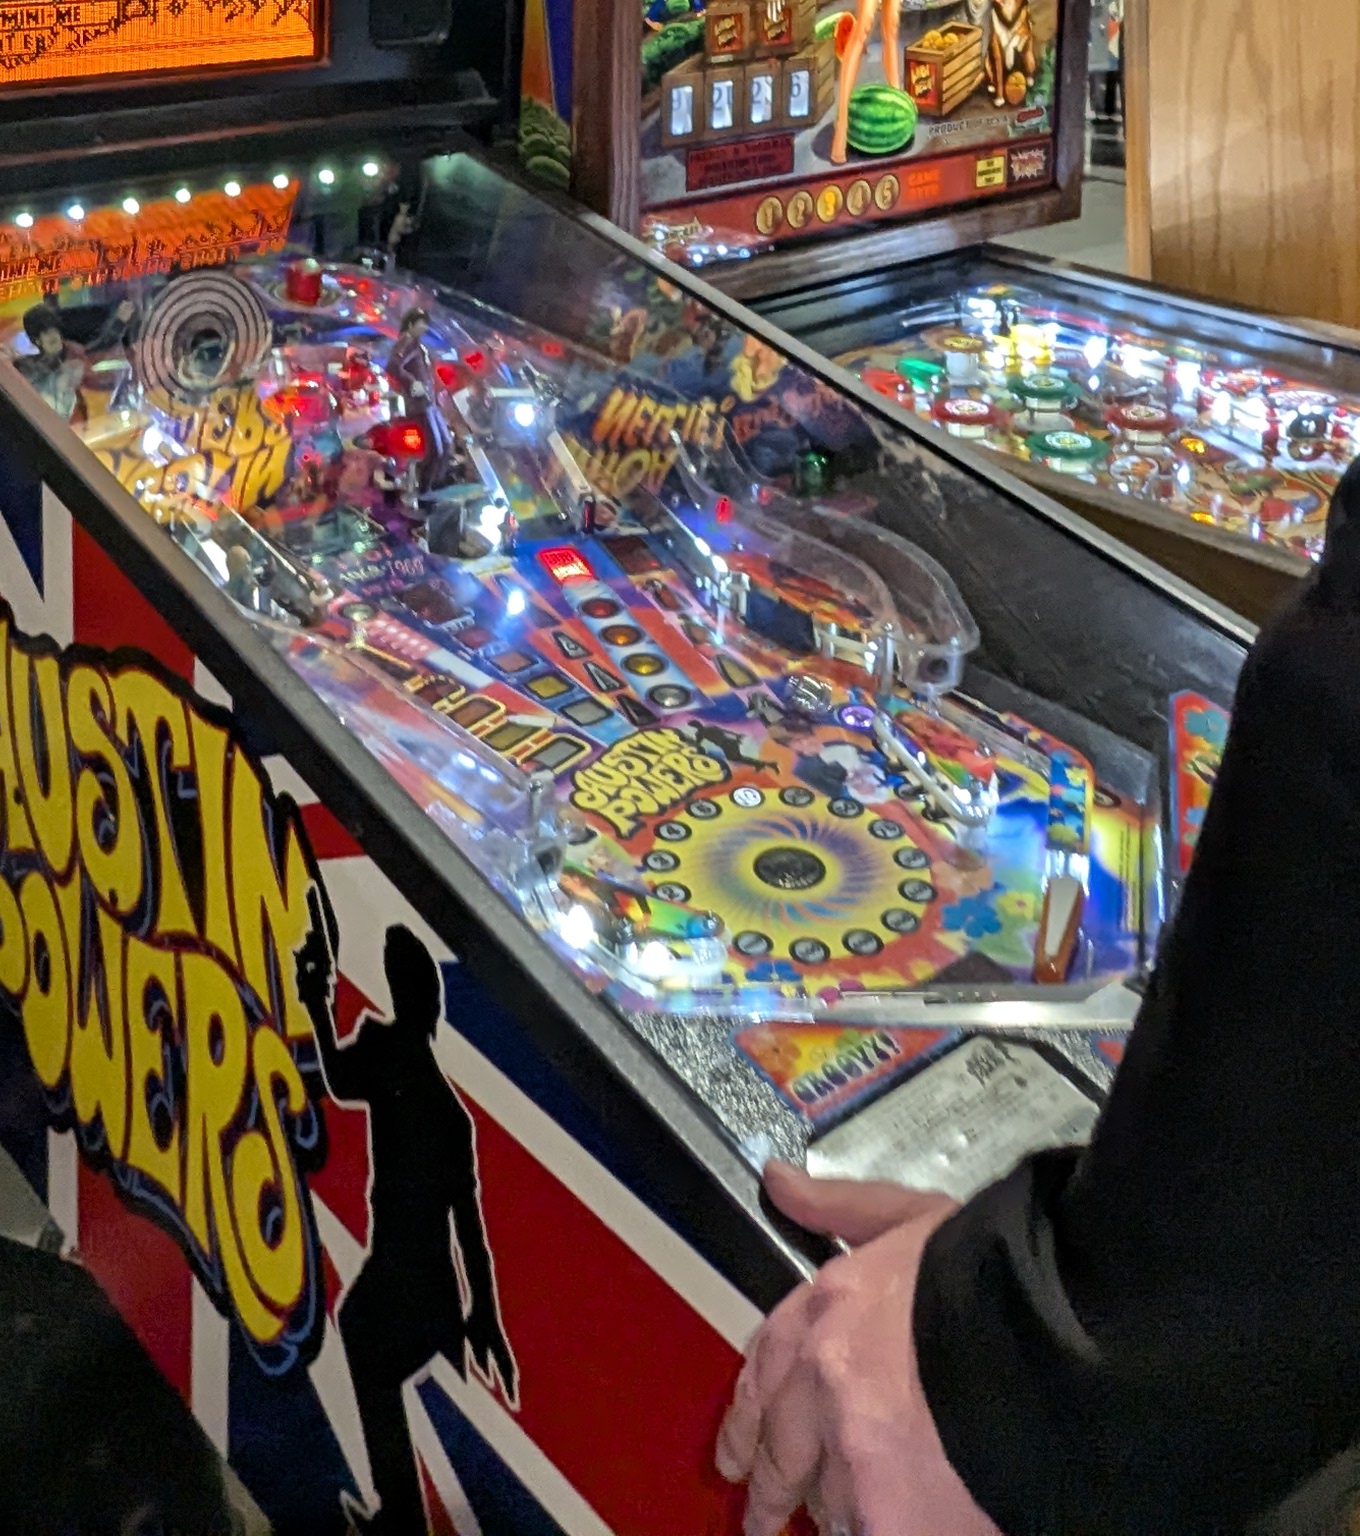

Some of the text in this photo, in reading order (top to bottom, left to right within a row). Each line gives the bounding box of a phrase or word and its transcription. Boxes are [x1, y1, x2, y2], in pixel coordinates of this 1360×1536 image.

[574, 729, 682, 809] AUSTIN
[602, 746, 723, 837] POWERS
[793, 1030, 902, 1103] GROOVY!
